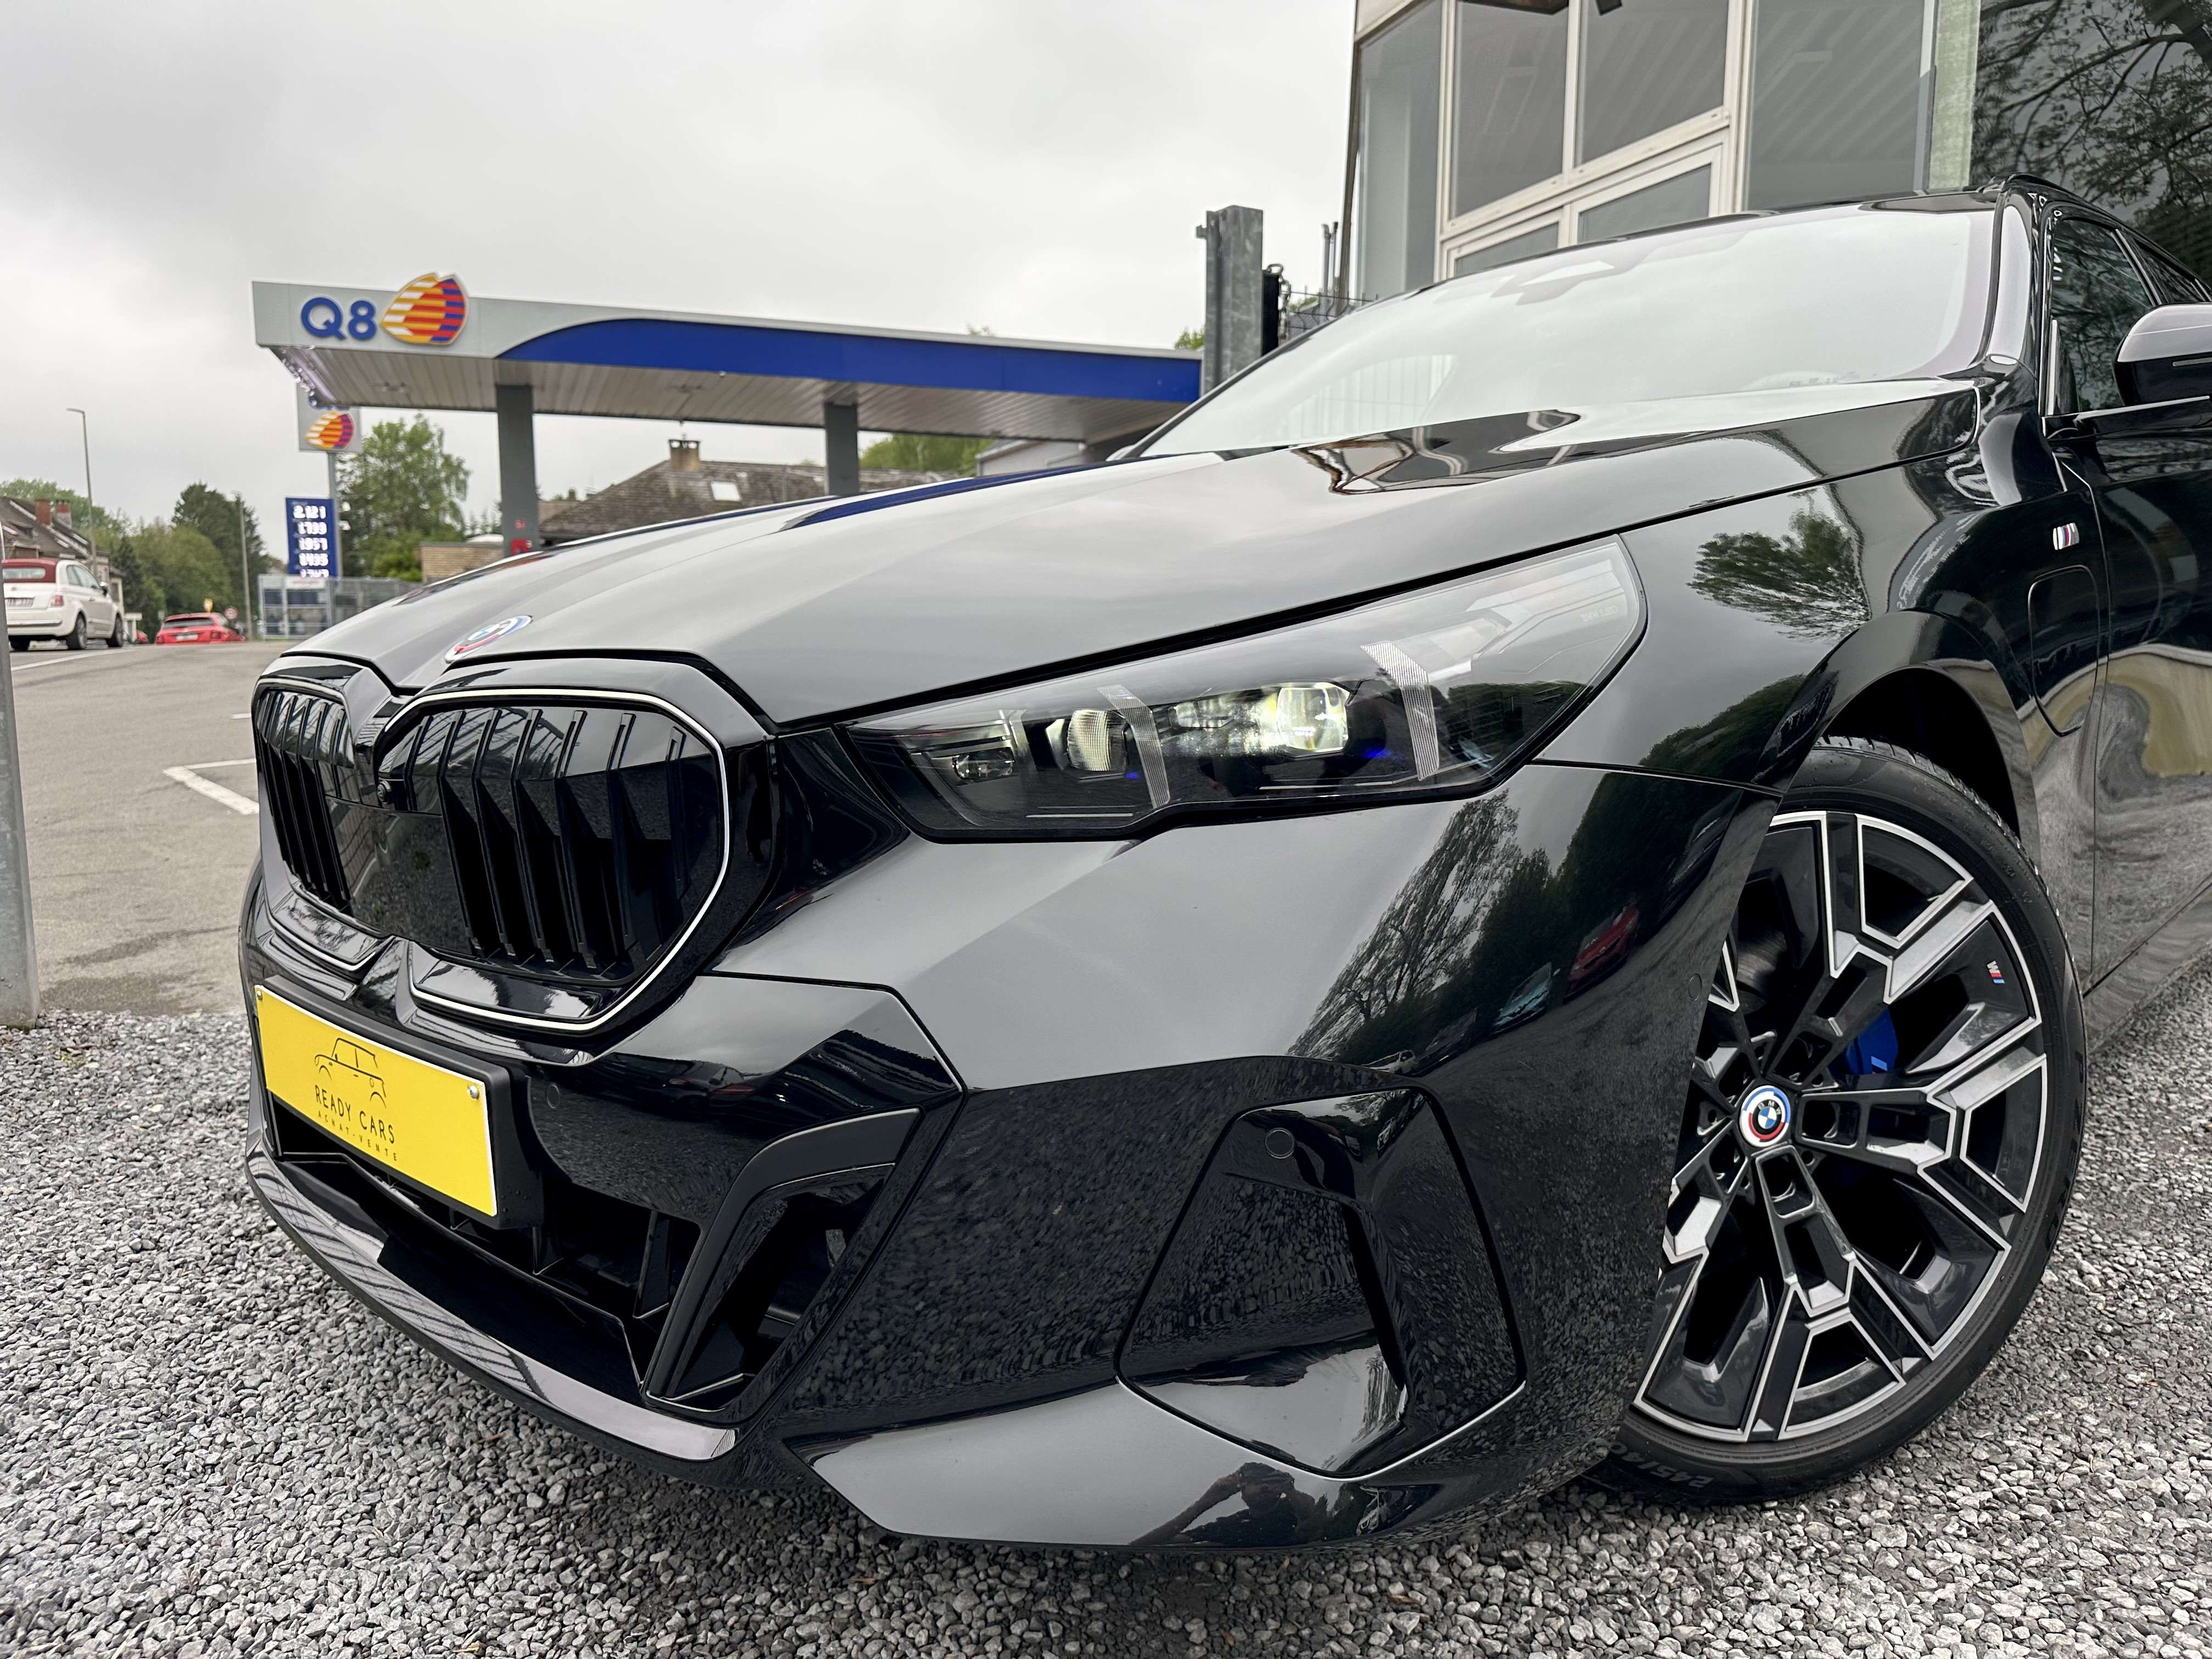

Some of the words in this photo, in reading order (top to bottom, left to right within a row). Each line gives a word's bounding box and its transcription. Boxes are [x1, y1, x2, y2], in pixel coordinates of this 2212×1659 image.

[301, 297, 377, 341] Q8
[315, 1084, 351, 1121] READY
[359, 1110, 395, 1144] CARS
[1757, 1100, 1782, 1115] BMW
